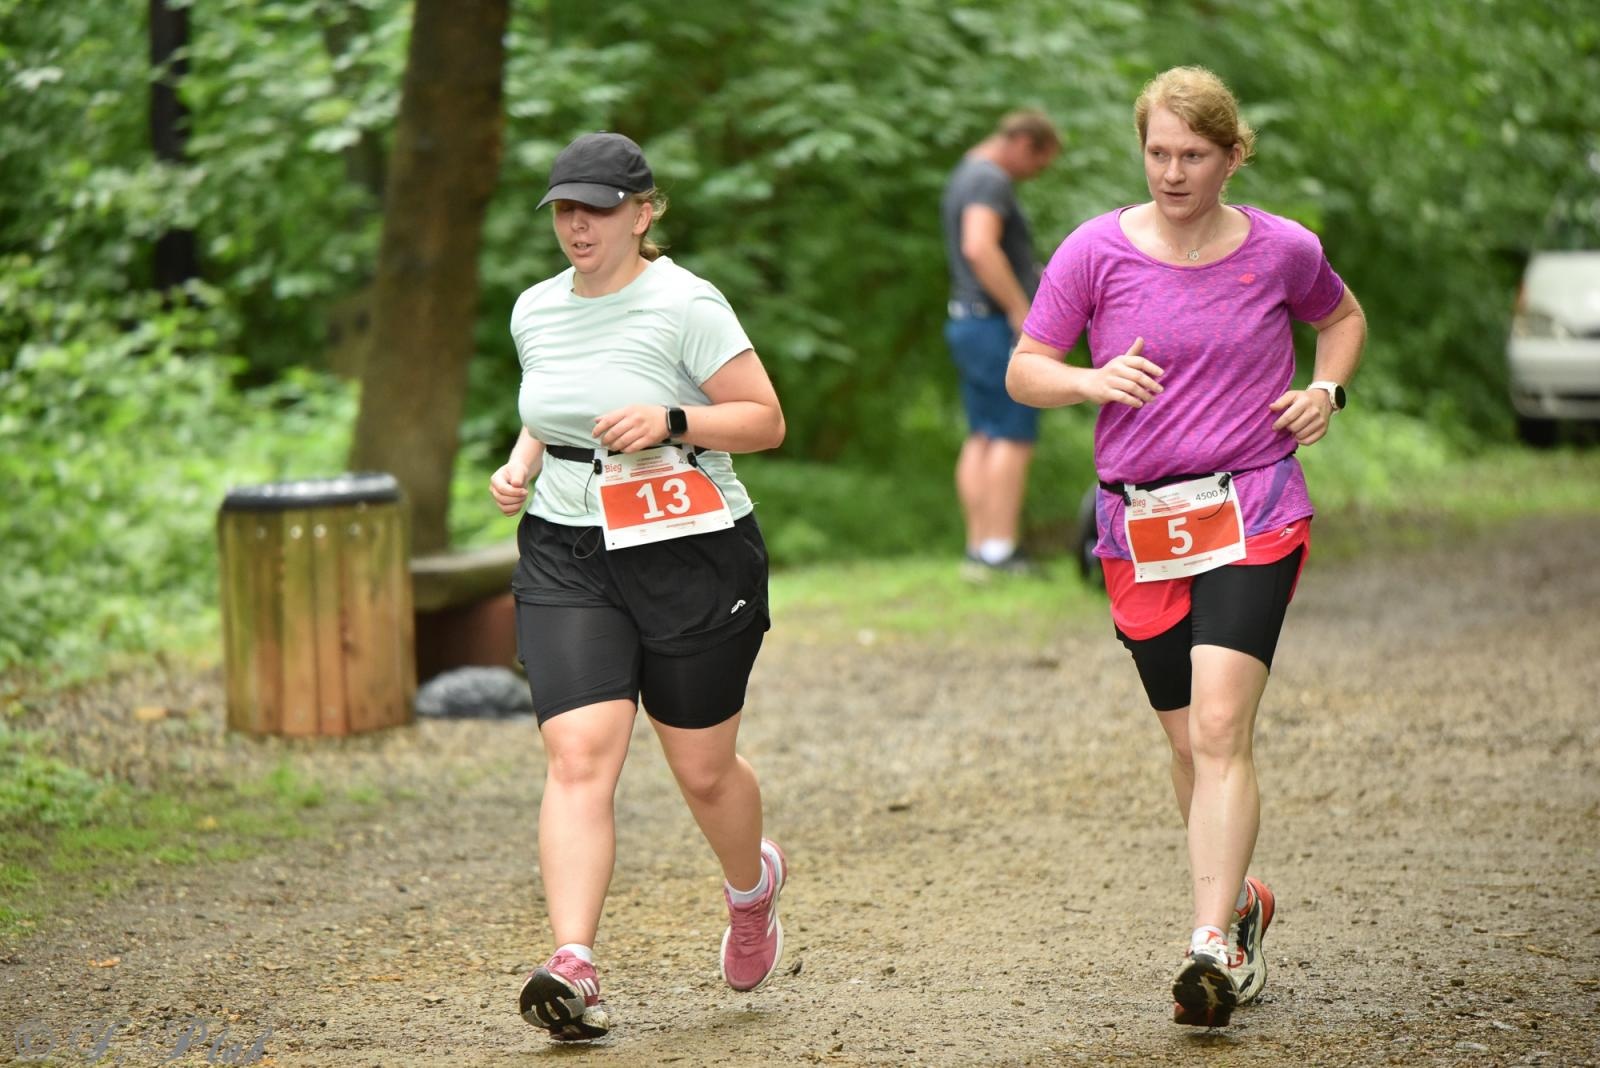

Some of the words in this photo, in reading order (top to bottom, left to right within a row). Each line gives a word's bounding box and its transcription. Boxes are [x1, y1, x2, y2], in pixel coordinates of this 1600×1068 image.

[636, 478, 691, 519] 13
[1195, 490, 1218, 501] 4500
[1167, 516, 1193, 555] 5
